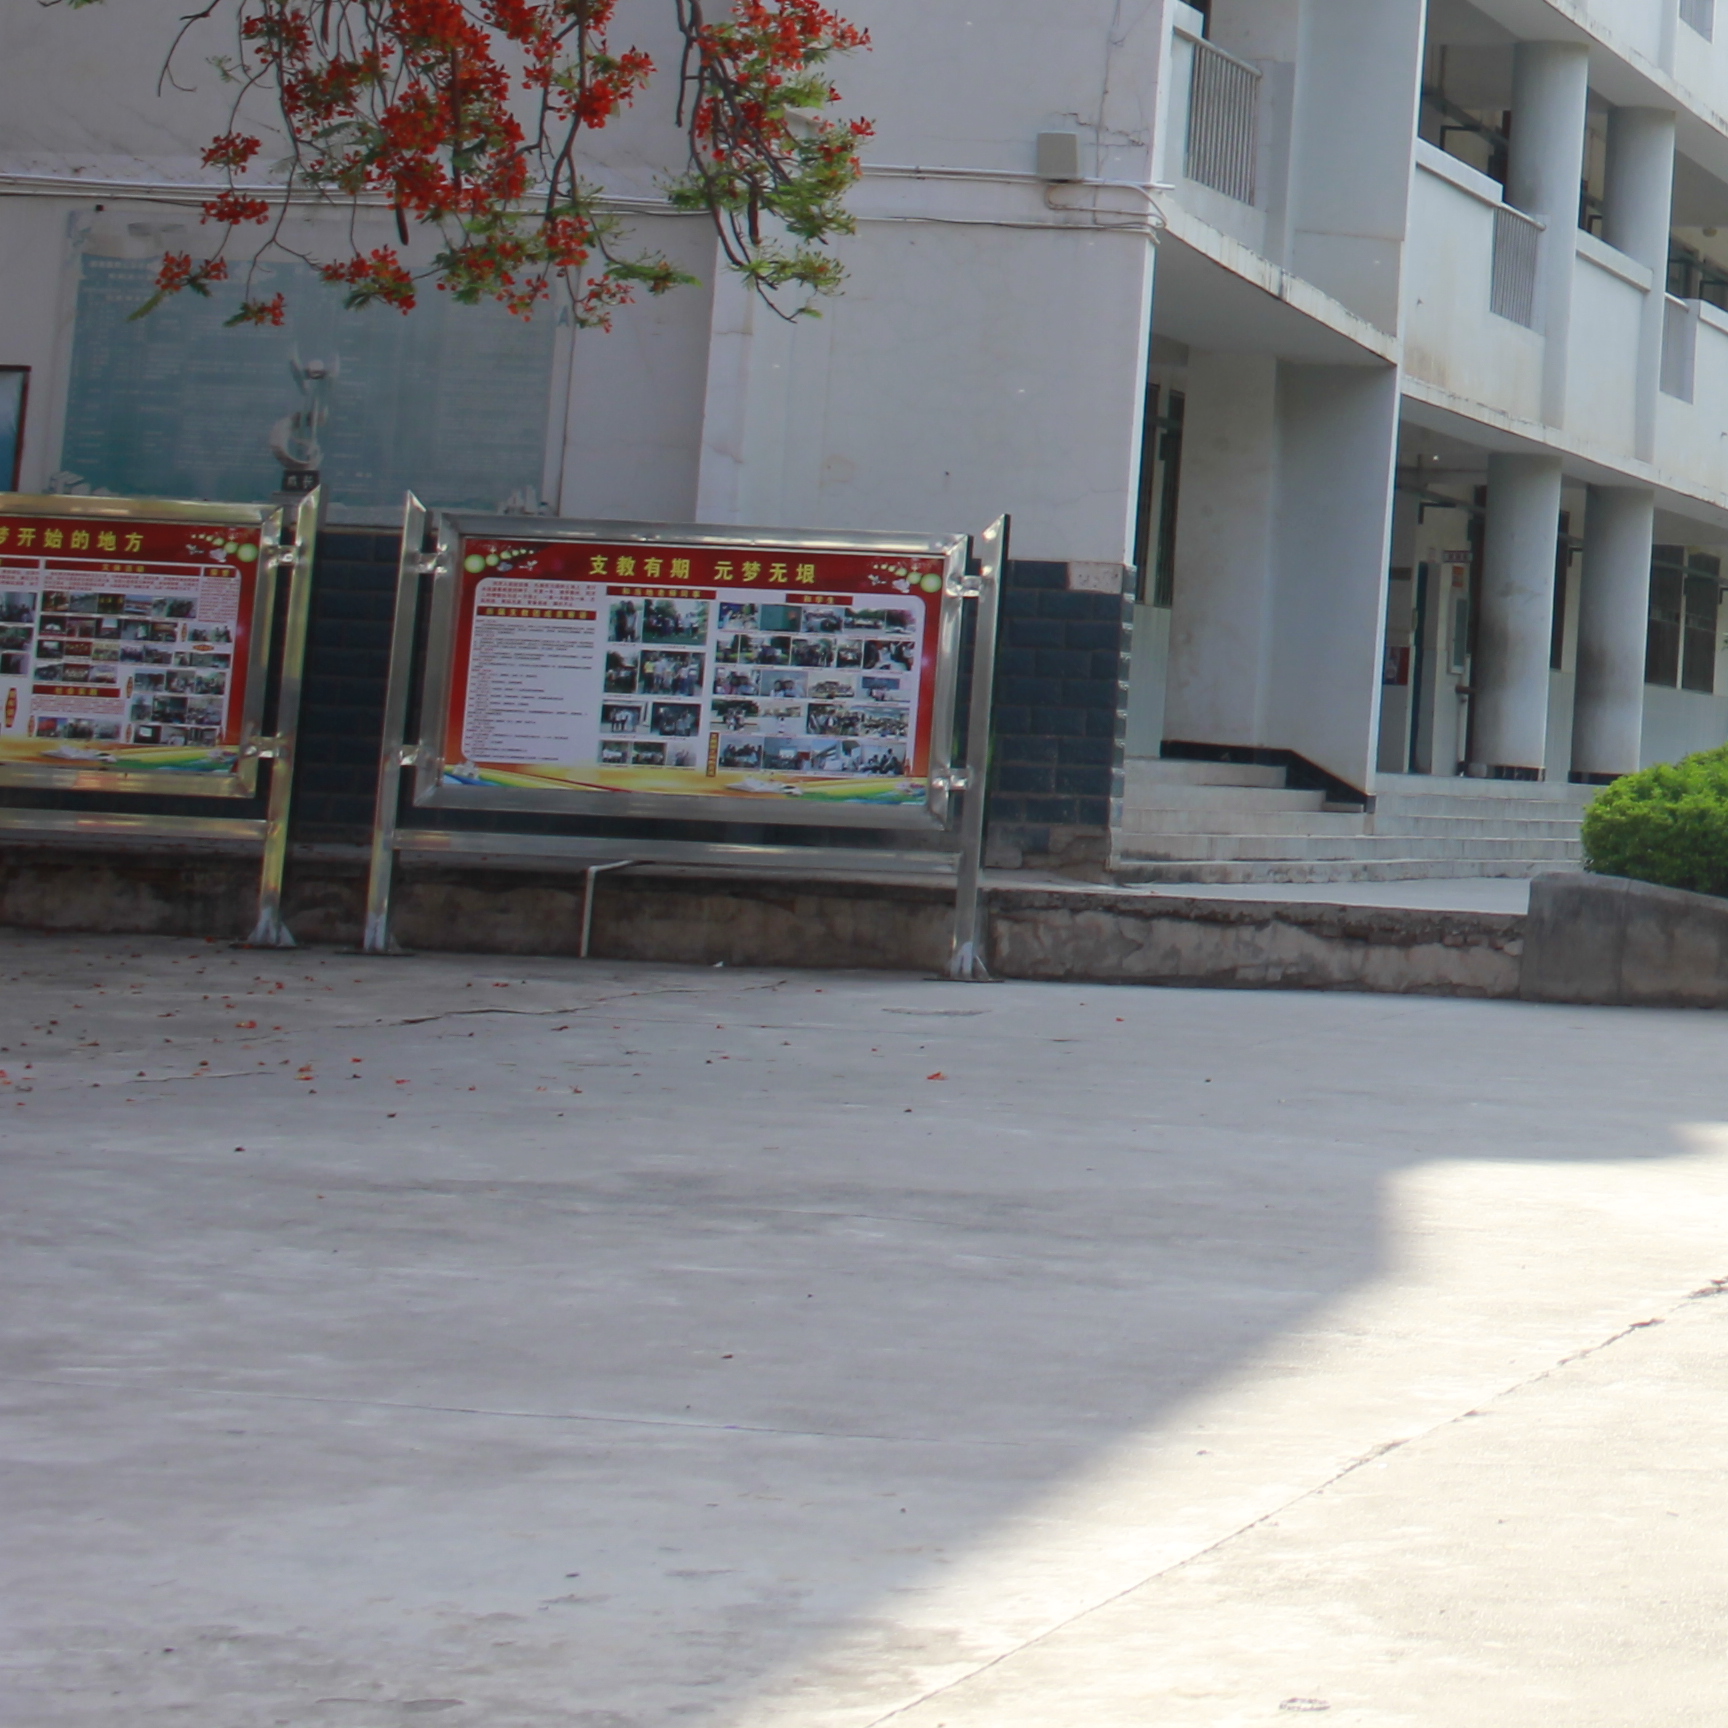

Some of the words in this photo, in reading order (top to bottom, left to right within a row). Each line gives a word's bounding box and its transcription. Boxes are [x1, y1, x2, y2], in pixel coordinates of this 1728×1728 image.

[588, 554, 691, 580] 支教有期
[713, 559, 816, 584] 元梦无垠
